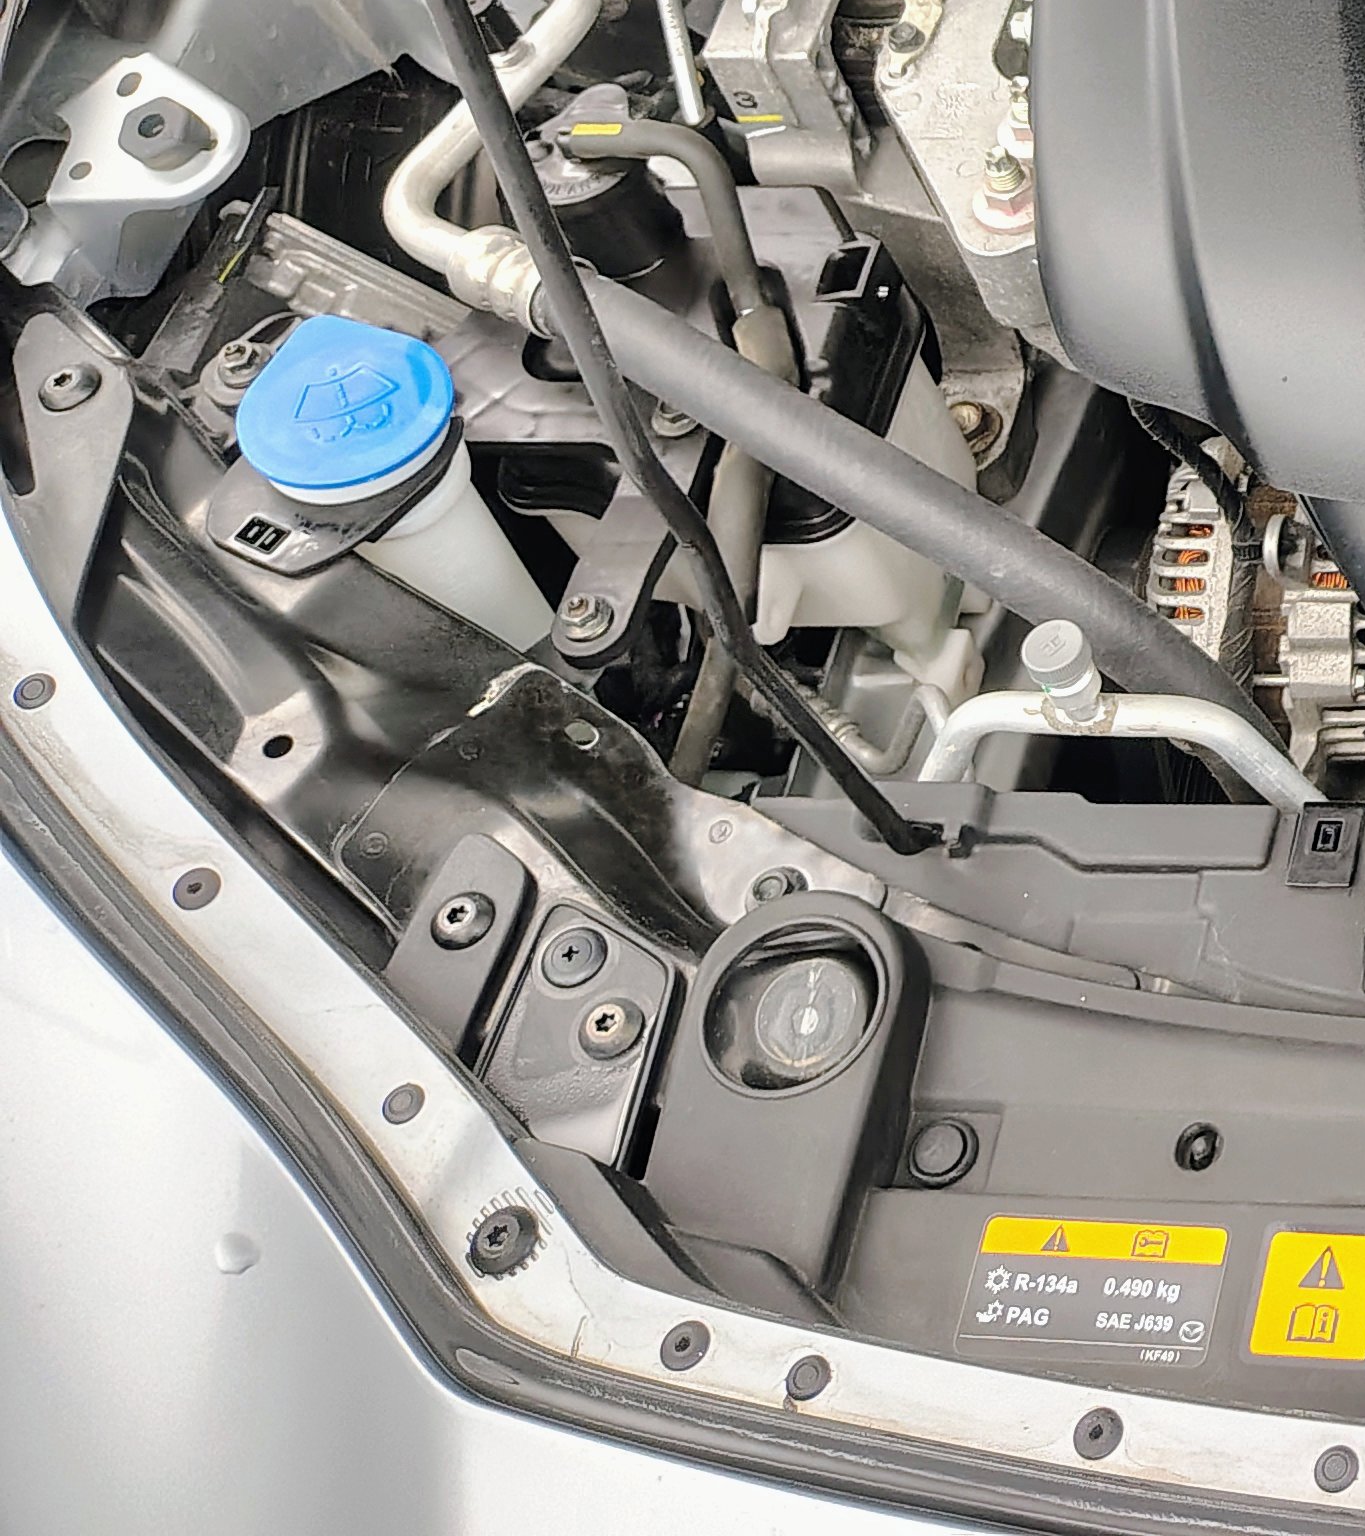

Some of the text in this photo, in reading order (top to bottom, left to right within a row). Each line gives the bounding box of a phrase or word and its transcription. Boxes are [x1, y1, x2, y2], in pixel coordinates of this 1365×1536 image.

[1014, 1273, 1181, 1304] R-134a 0.490 kg
[1006, 1306, 1173, 1333] PAG SAE J639
